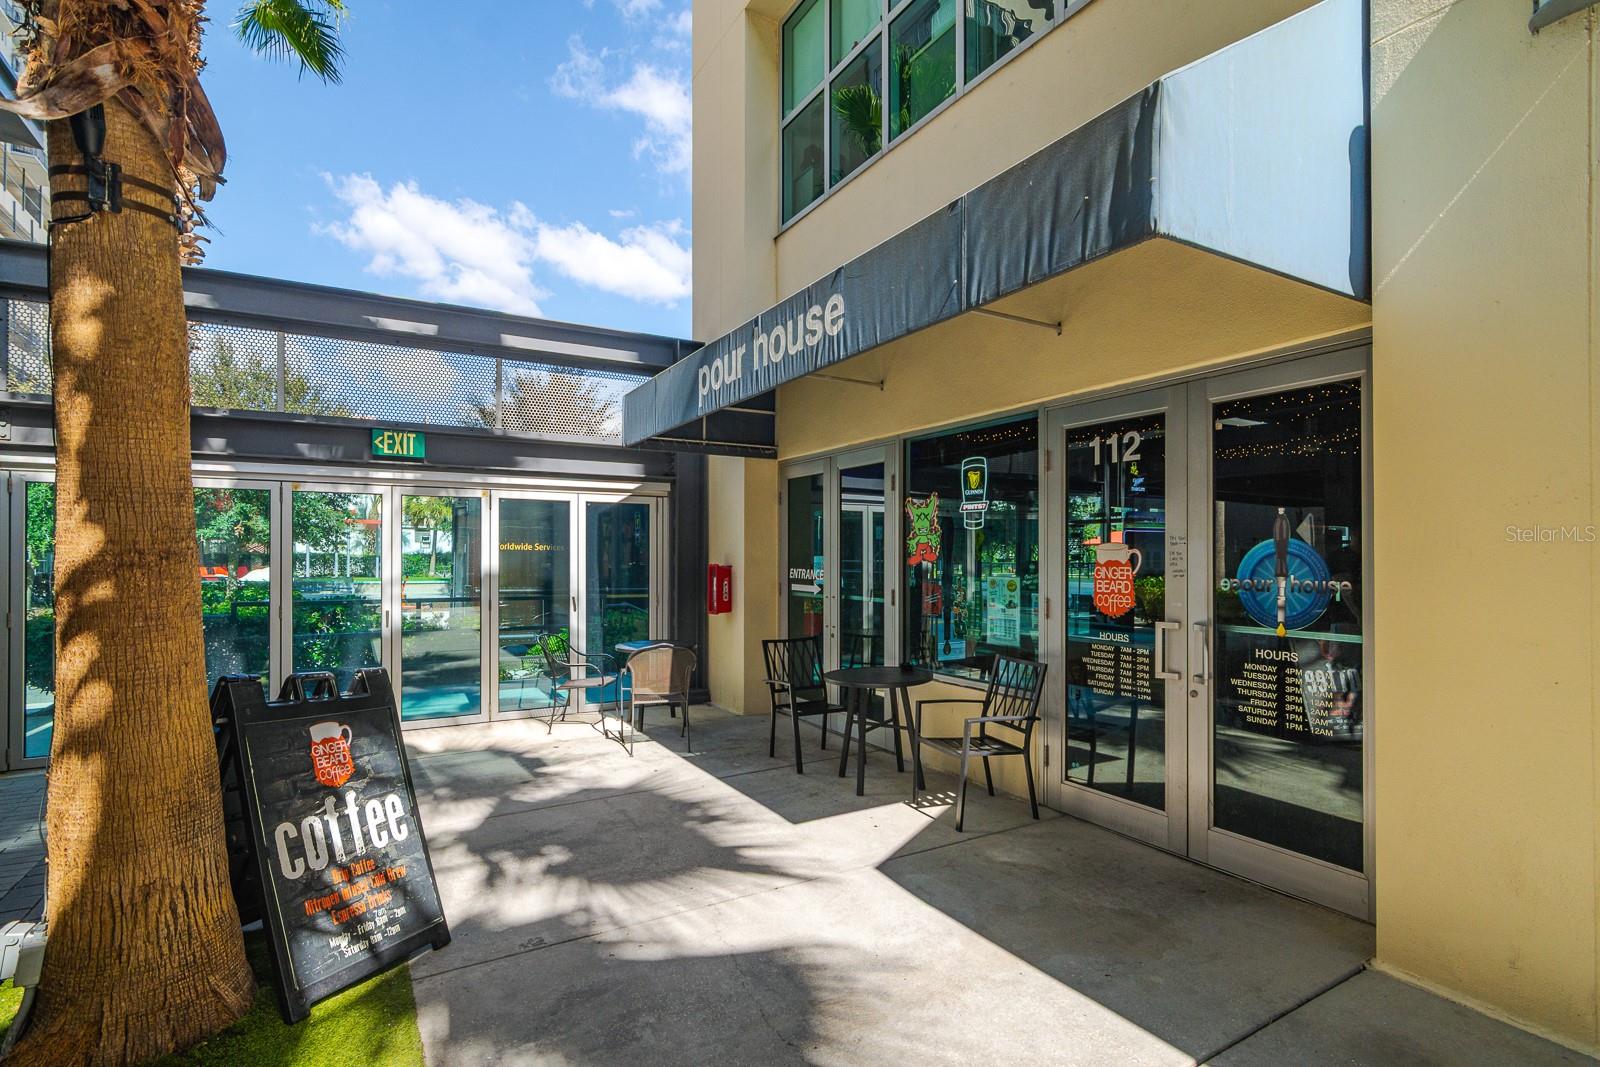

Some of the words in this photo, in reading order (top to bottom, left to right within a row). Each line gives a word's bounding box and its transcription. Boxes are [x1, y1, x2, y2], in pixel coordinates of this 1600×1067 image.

[698, 343, 746, 408] pour
[753, 293, 845, 371] house
[384, 431, 416, 455] EXIT
[1089, 430, 1141, 466] 112
[500, 543, 533, 551] orldwide
[789, 568, 824, 580] ENTRANCE
[1094, 565, 1132, 580] GINGER
[1096, 580, 1131, 593] BEARD
[1290, 574, 1352, 595] house
[1096, 593, 1131, 613] coffee
[1099, 632, 1129, 643] HOURS
[1091, 643, 1115, 652] MONDAY
[1082, 657, 1115, 667] WEDNESDAY
[1120, 661, 1132, 669] 7AM
[1090, 650, 1115, 660] TUESDAY
[1120, 654, 1132, 662] 7AM
[1255, 649, 1299, 663] HOURS
[1087, 664, 1115, 674] THURSDAY
[1120, 669, 1132, 677] 7AM
[1095, 673, 1115, 681] FRIDAY
[1244, 662, 1277, 673] MONDAY
[1285, 668, 1303, 676] 4PM
[1088, 679, 1115, 689] SATURDAY
[1231, 678, 1277, 691] WEDNESDAY
[1285, 685, 1303, 694] 3PM
[1243, 671, 1277, 682] TUESDAY
[1285, 676, 1303, 685] 3PM
[1093, 687, 1115, 696] SUNDAY
[1237, 688, 1277, 700] THURSDAY
[1285, 695, 1303, 704] 3PM
[1238, 705, 1277, 718] SATURDAY
[1286, 713, 1303, 722] 1PM
[1250, 698, 1277, 708] FRIDAY
[1285, 704, 1303, 713] 3PM
[1246, 715, 1277, 727] SUNDAY
[1286, 722, 1303, 732] 1PM
[311, 739, 349, 757] GINGER
[316, 752, 350, 769] BEARD
[319, 764, 351, 783] coffee
[274, 790, 408, 880] coffee
[350, 858, 376, 877] Coffee
[304, 891, 339, 918] Nitrogen
[386, 864, 406, 882] Brew
[331, 902, 367, 926] Espresso
[343, 939, 369, 958] Saturday
